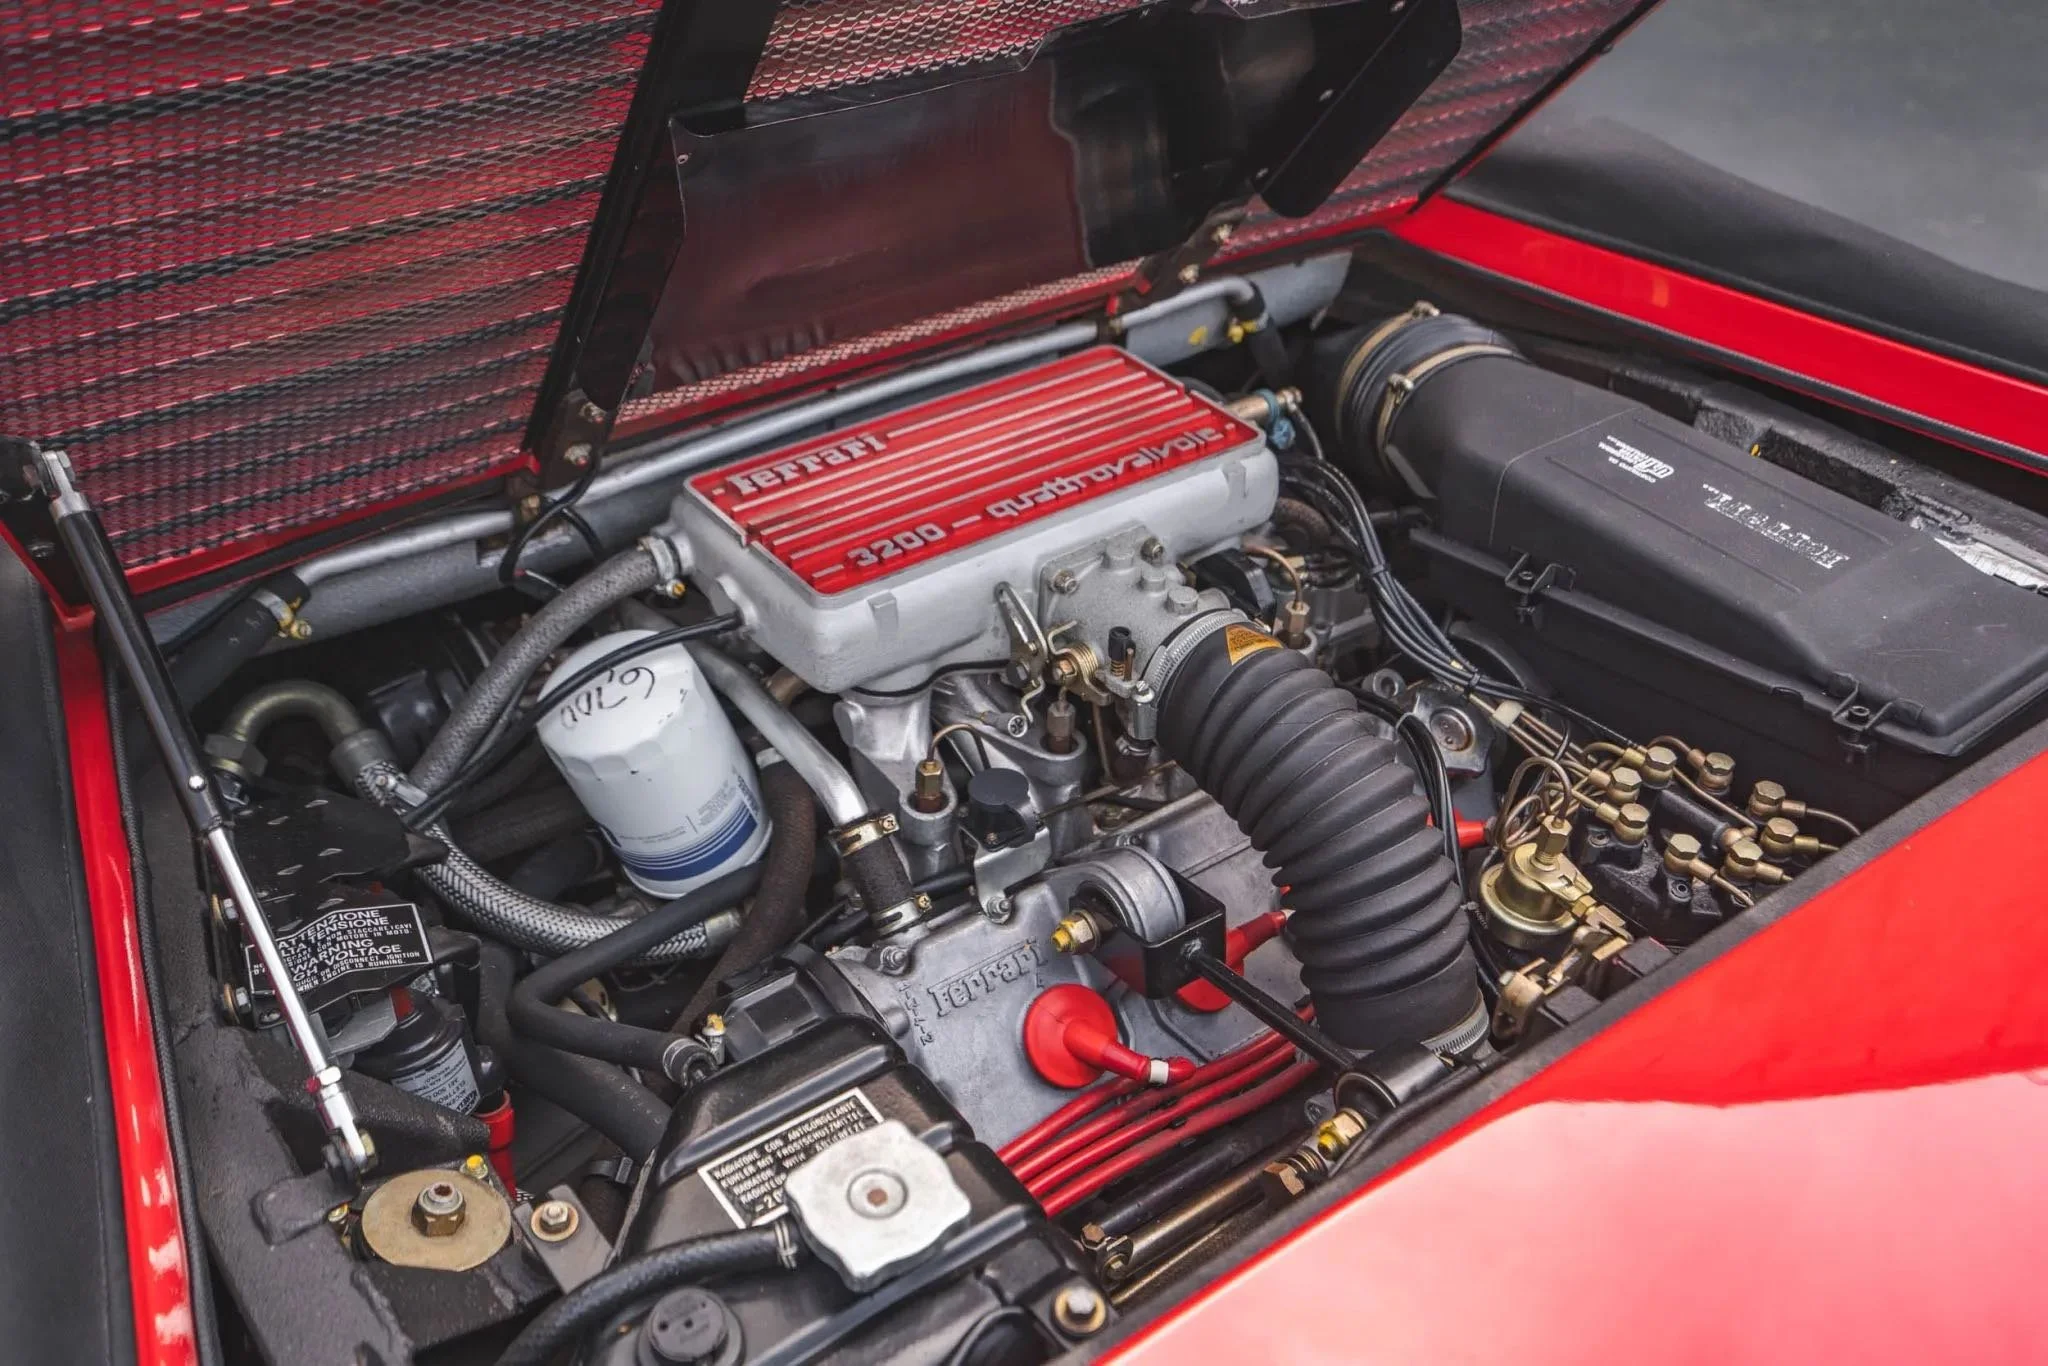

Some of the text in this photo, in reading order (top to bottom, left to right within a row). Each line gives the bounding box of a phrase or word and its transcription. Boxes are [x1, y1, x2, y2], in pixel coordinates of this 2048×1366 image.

[726, 433, 887, 495] Ferrari
[848, 427, 1224, 567] 3200 quattrovalvole
[279, 910, 380, 949] ATTENZIONE
[281, 916, 389, 957] LTA TENSIONE
[337, 933, 368, 942] MOTORE
[347, 925, 387, 935] STACCARE
[291, 939, 374, 974] WARNING
[293, 944, 402, 981] GH VOLTAGE
[322, 965, 351, 982] ENGINE
[333, 956, 379, 970] DISCONNECT
[387, 952, 420, 960] IGNITION
[927, 936, 1048, 1017] Ferrari
[713, 1101, 856, 1179] RADIATORE CON ANTICONGELANTE
[757, 1155, 774, 1170] MIT
[776, 1111, 864, 1159] FROSTSCHUTZMITTEL
[733, 1168, 775, 1195] RADIATOR
